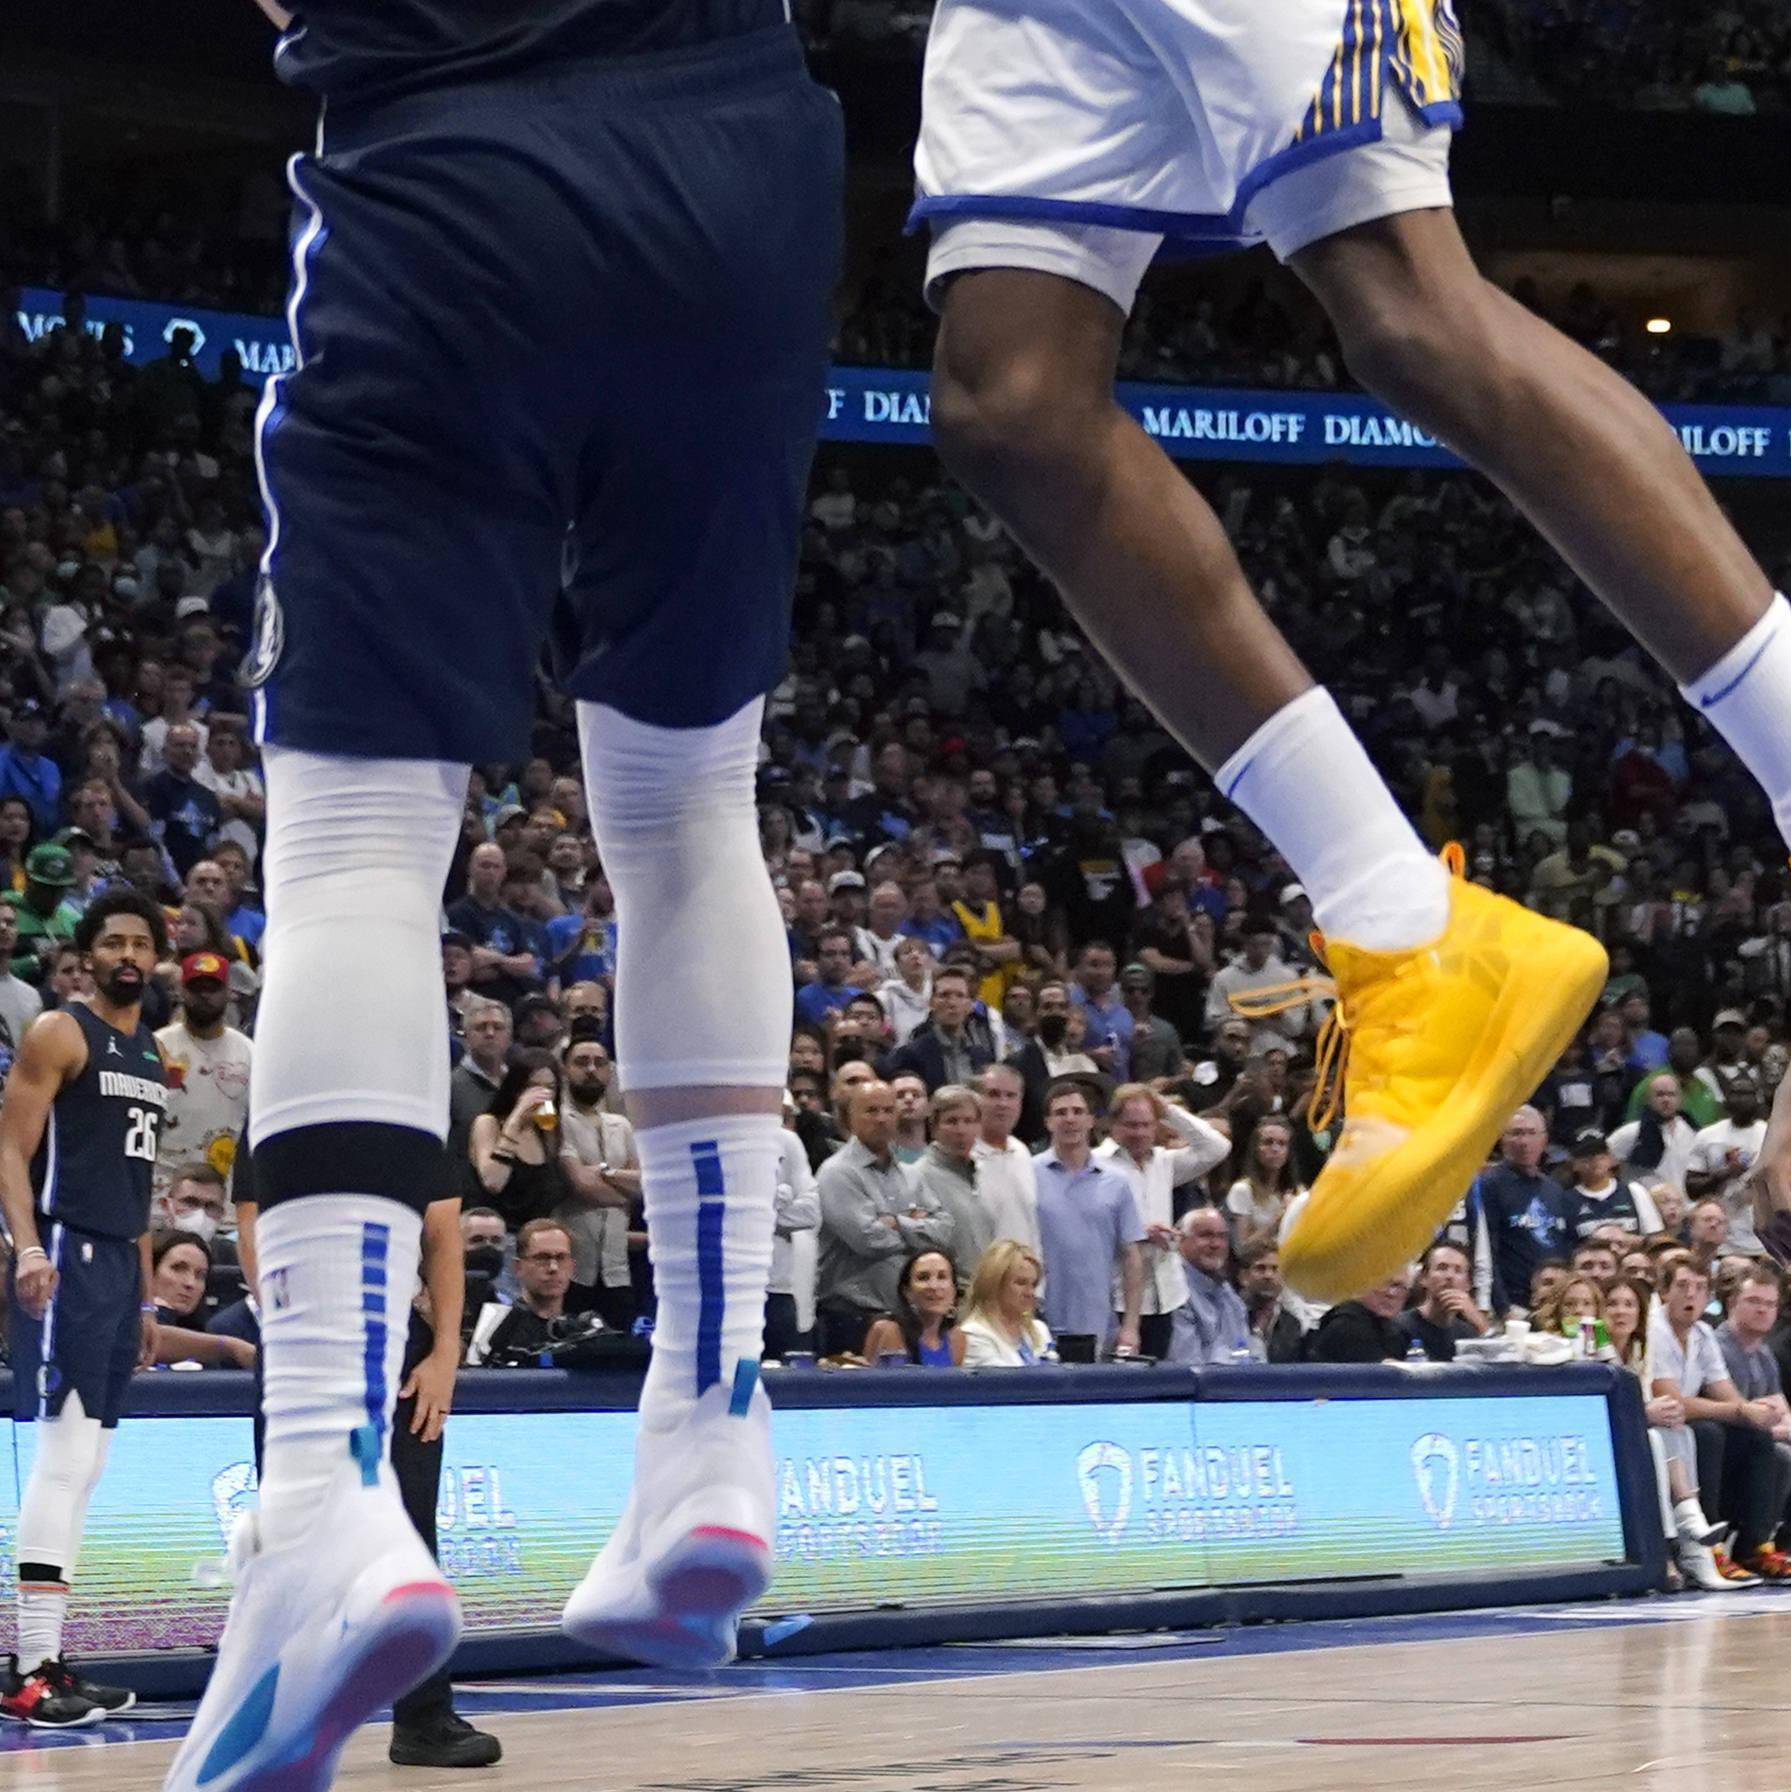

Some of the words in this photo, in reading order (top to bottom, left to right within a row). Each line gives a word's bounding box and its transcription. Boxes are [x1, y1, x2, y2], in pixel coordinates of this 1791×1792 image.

[1143, 406, 1306, 445] MARILOFF
[125, 1106, 158, 1162] 26
[1140, 1445, 1295, 1504] FANDUEL
[1465, 1435, 1598, 1490] FANDUEL
